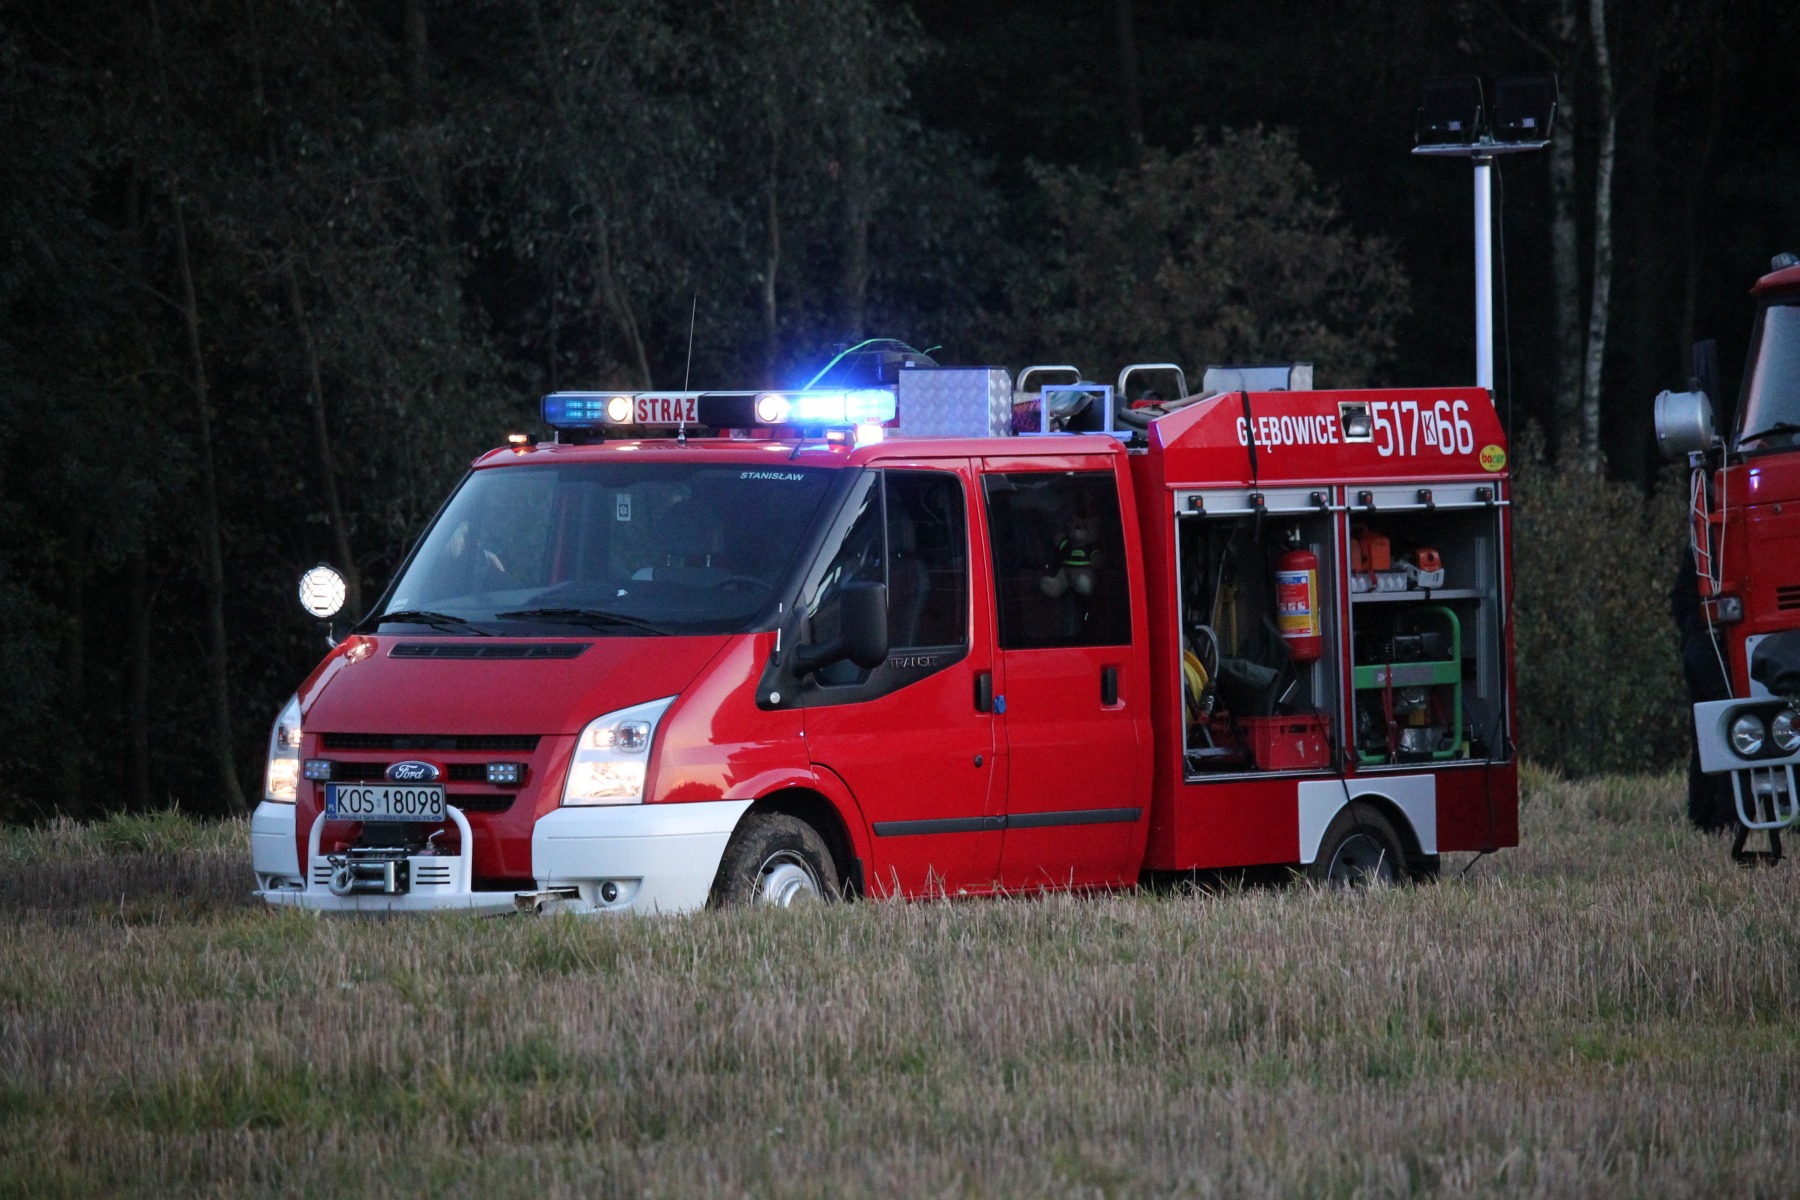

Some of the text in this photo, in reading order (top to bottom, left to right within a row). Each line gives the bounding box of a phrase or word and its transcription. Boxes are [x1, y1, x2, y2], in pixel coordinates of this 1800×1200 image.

[1236, 415, 1339, 454] GŁĘBOWICE
[740, 472, 804, 481] STANISŁAW
[888, 656, 938, 669] TRANSIT
[395, 764, 425, 780] Ford
[337, 789, 441, 815] KOS 18098
